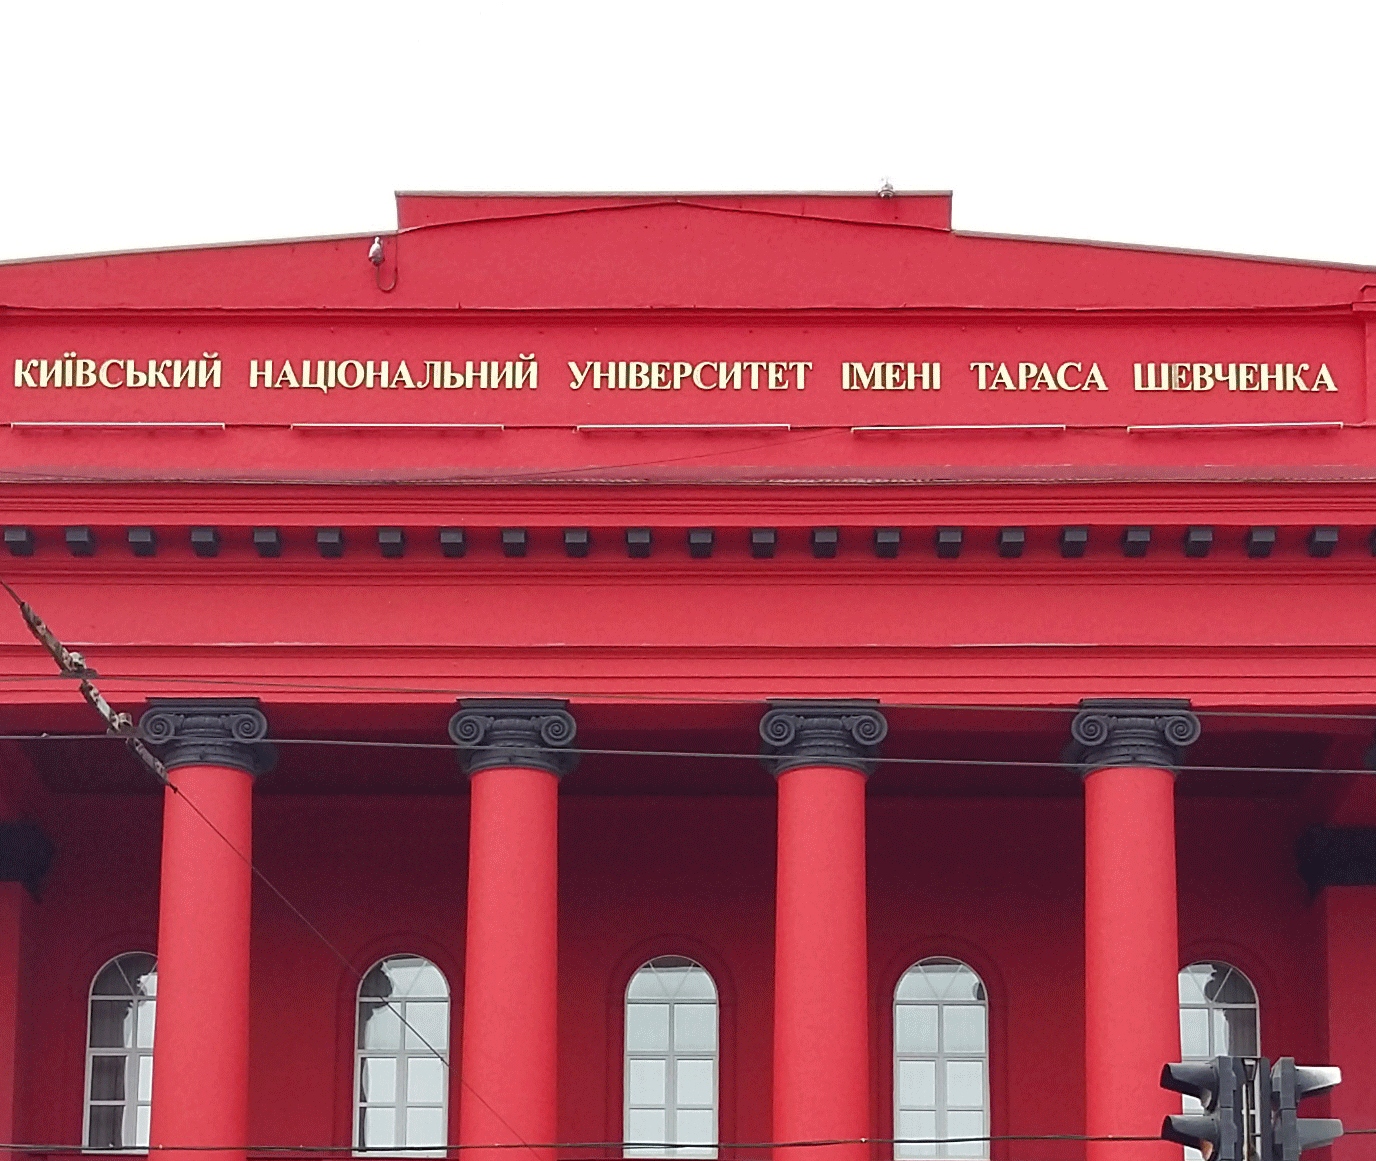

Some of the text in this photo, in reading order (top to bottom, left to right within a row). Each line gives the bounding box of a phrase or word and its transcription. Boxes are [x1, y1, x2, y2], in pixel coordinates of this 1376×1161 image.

[13, 351, 1339, 393] КИЇВСЬКИЙ НАЦІОНАЛЬНИЙ УНІВЕРСИТЕТ ІМЕНІ ТАРАСА ШЕВЧЕНКА
